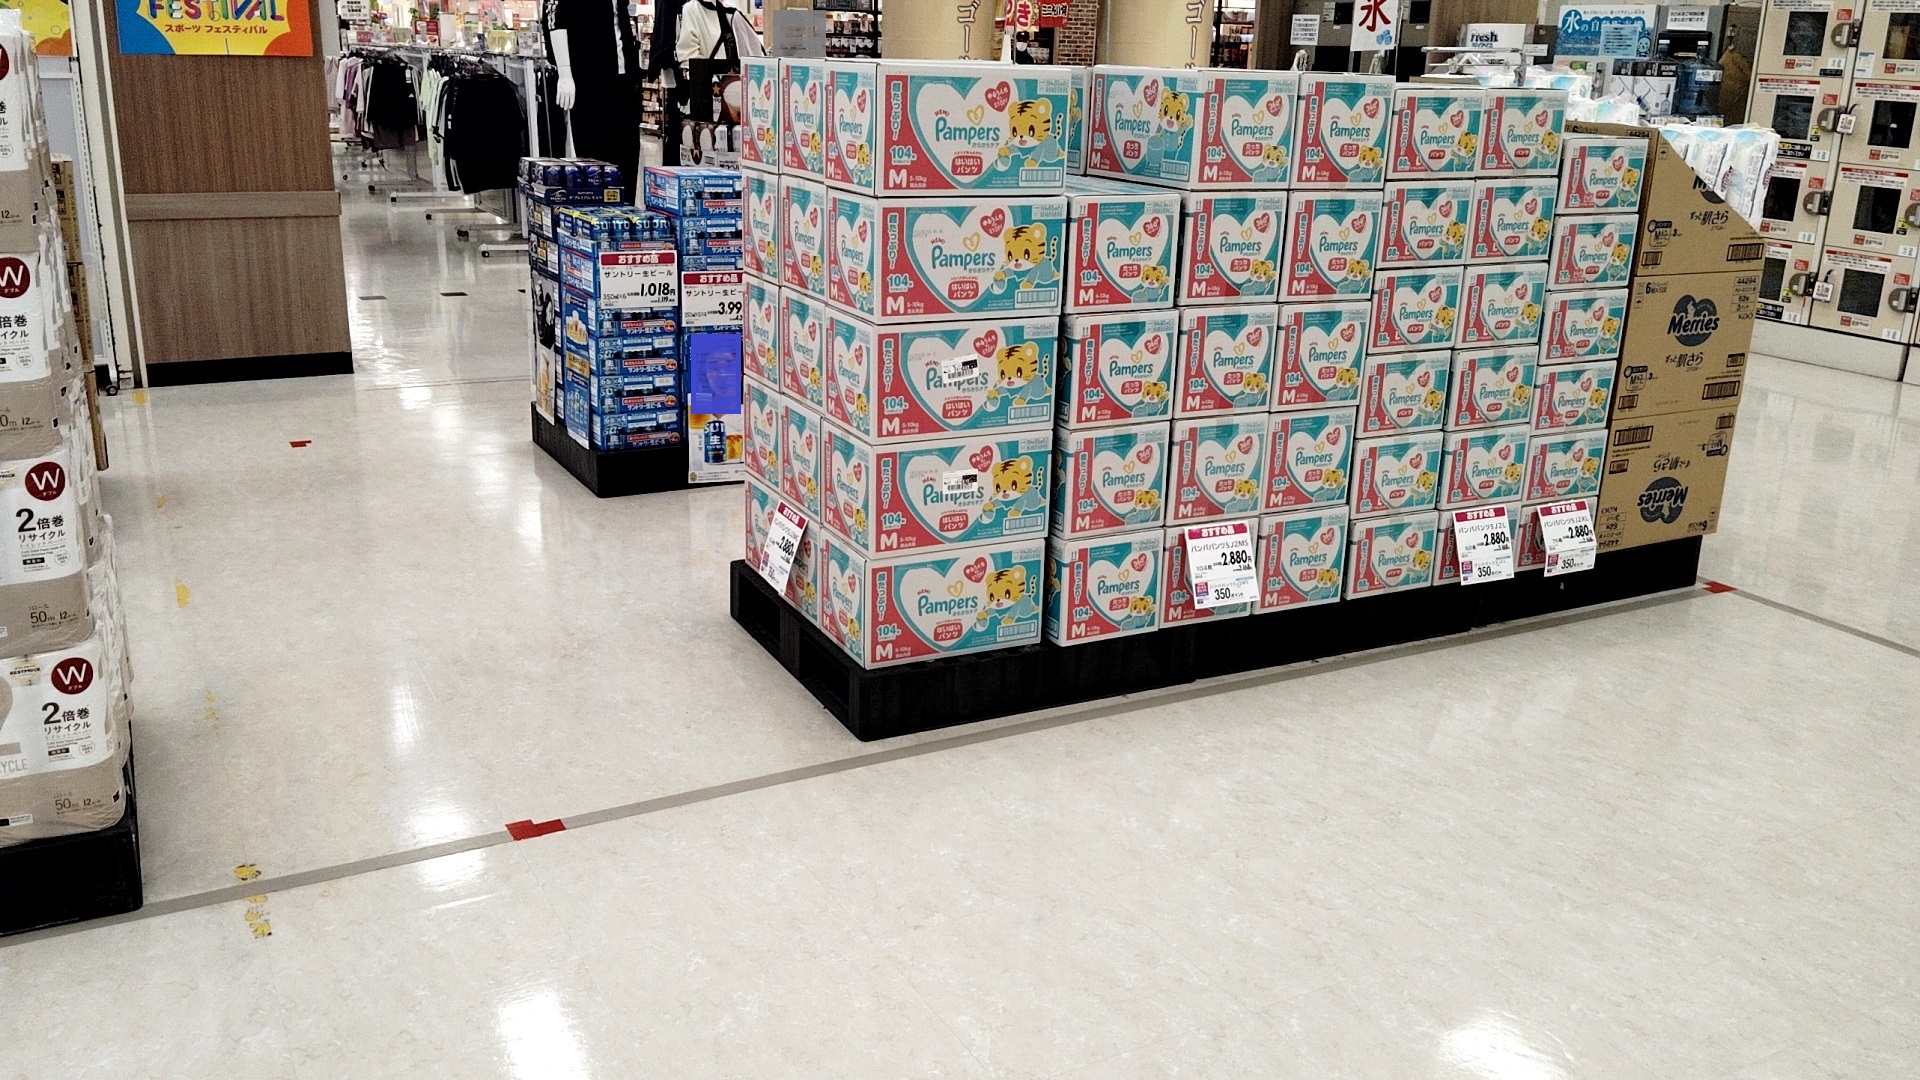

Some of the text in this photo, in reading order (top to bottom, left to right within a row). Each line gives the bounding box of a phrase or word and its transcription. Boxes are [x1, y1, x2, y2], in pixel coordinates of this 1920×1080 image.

[149, 0, 285, 21] FESTIVAL
[1359, 0, 1391, 32] 氷
[164, 24, 268, 34] スポーツ フェスティバル
[840, 114, 862, 137] Pampers
[935, 117, 1000, 145] Pampers
[1115, 110, 1150, 136] Pampers
[1231, 119, 1274, 138] Pampers
[1330, 121, 1370, 139] Pampers
[1420, 130, 1456, 145] Pampers
[1507, 129, 1540, 144] Pampers
[955, 158, 980, 166] はいはい
[1091, 151, 1100, 168] M
[889, 168, 907, 188] M
[956, 166, 979, 174] パンツ
[1204, 165, 1218, 181] M
[1302, 165, 1316, 181] M
[1589, 173, 1618, 186] Pampers
[1410, 221, 1444, 236] Pampers
[1497, 218, 1529, 234] Pampers
[842, 240, 863, 263] Pampers
[1107, 241, 1152, 261] Pampers
[1220, 237, 1261, 255] Pampers
[1319, 236, 1358, 254] Pampers
[931, 245, 996, 271] Pampers
[604, 270, 673, 278] サントリー生ビール
[951, 283, 977, 291] はいはい
[953, 291, 975, 299] パンツ
[1192, 281, 1206, 296] M
[1291, 280, 1305, 295] M
[1079, 288, 1094, 304] M
[886, 296, 904, 315] M
[1488, 304, 1519, 319] Pampers
[1400, 307, 1433, 321] Pampers
[1668, 312, 1720, 335] Merries
[1213, 351, 1254, 370] Pampers
[1309, 347, 1347, 364] Pampers
[1110, 360, 1153, 378] Pampers
[1186, 395, 1200, 411] M
[1283, 389, 1295, 404] M
[1389, 392, 1422, 406] Pampers
[945, 401, 970, 410] はいはい
[947, 409, 968, 417] パンツ
[1082, 406, 1096, 421] M
[882, 416, 900, 435] M
[1295, 452, 1333, 467] Pampers
[1205, 461, 1245, 477] Pampers
[1472, 465, 1503, 478] Pampers
[31, 468, 61, 491] W
[1103, 472, 1146, 488] Pampers
[1382, 474, 1414, 487] Pampers
[1637, 486, 1688, 506] Merries
[16, 508, 64, 533] 2倍巻
[1076, 516, 1090, 531] M
[19, 530, 66, 543] リサイクル
[880, 532, 897, 551] M
[1289, 552, 1327, 568] Pampers
[1378, 554, 1410, 567] Pampers
[1098, 580, 1140, 596] Pampers
[917, 595, 978, 617] Pampers
[1168, 606, 1182, 621] M
[938, 631, 959, 639] パンツ
[1072, 622, 1085, 638] M
[875, 643, 893, 660] M
[56, 663, 87, 686] W
[41, 702, 90, 725] 2倍巻
[44, 722, 91, 735] リサイクル
